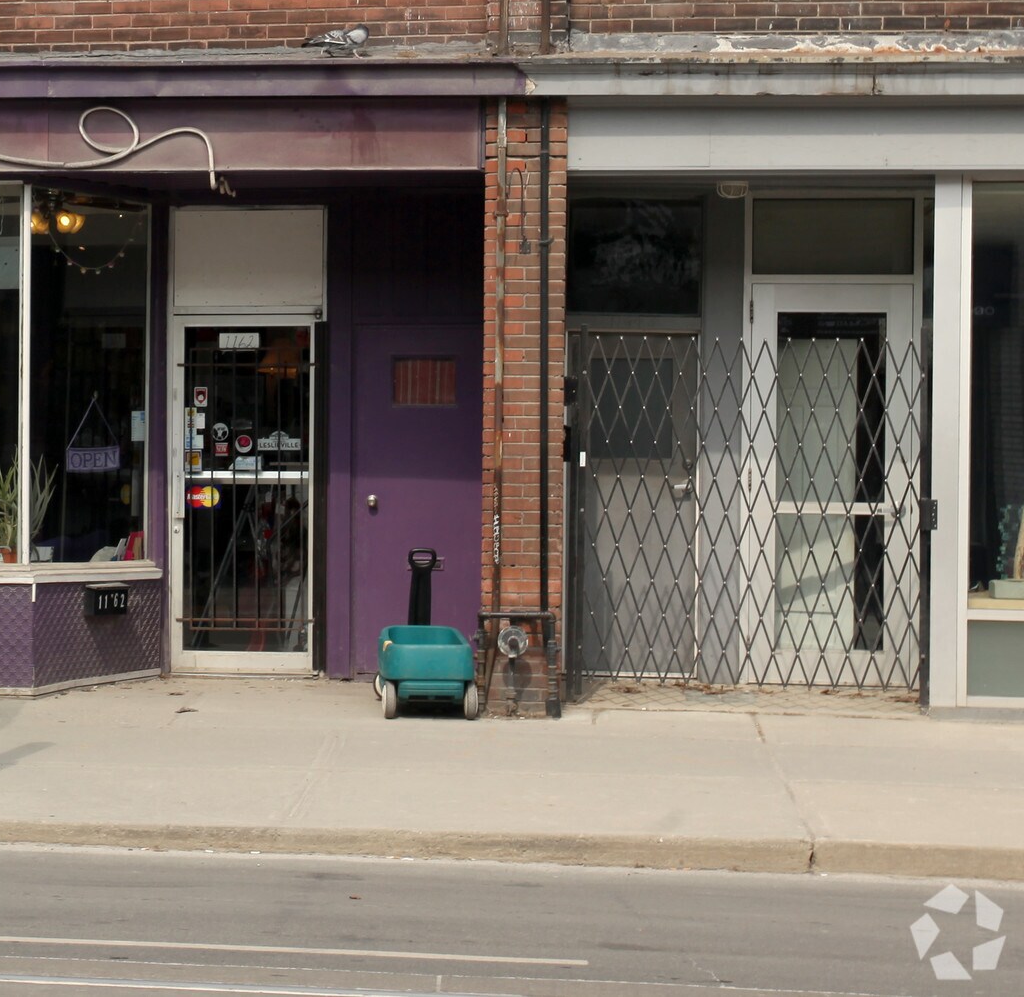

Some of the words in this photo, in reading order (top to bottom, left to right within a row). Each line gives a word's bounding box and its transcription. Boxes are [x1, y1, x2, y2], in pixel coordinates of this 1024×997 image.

[225, 335, 254, 349] 1162
[259, 441, 299, 449] LESLIVILLE
[70, 450, 117, 468] OPEN
